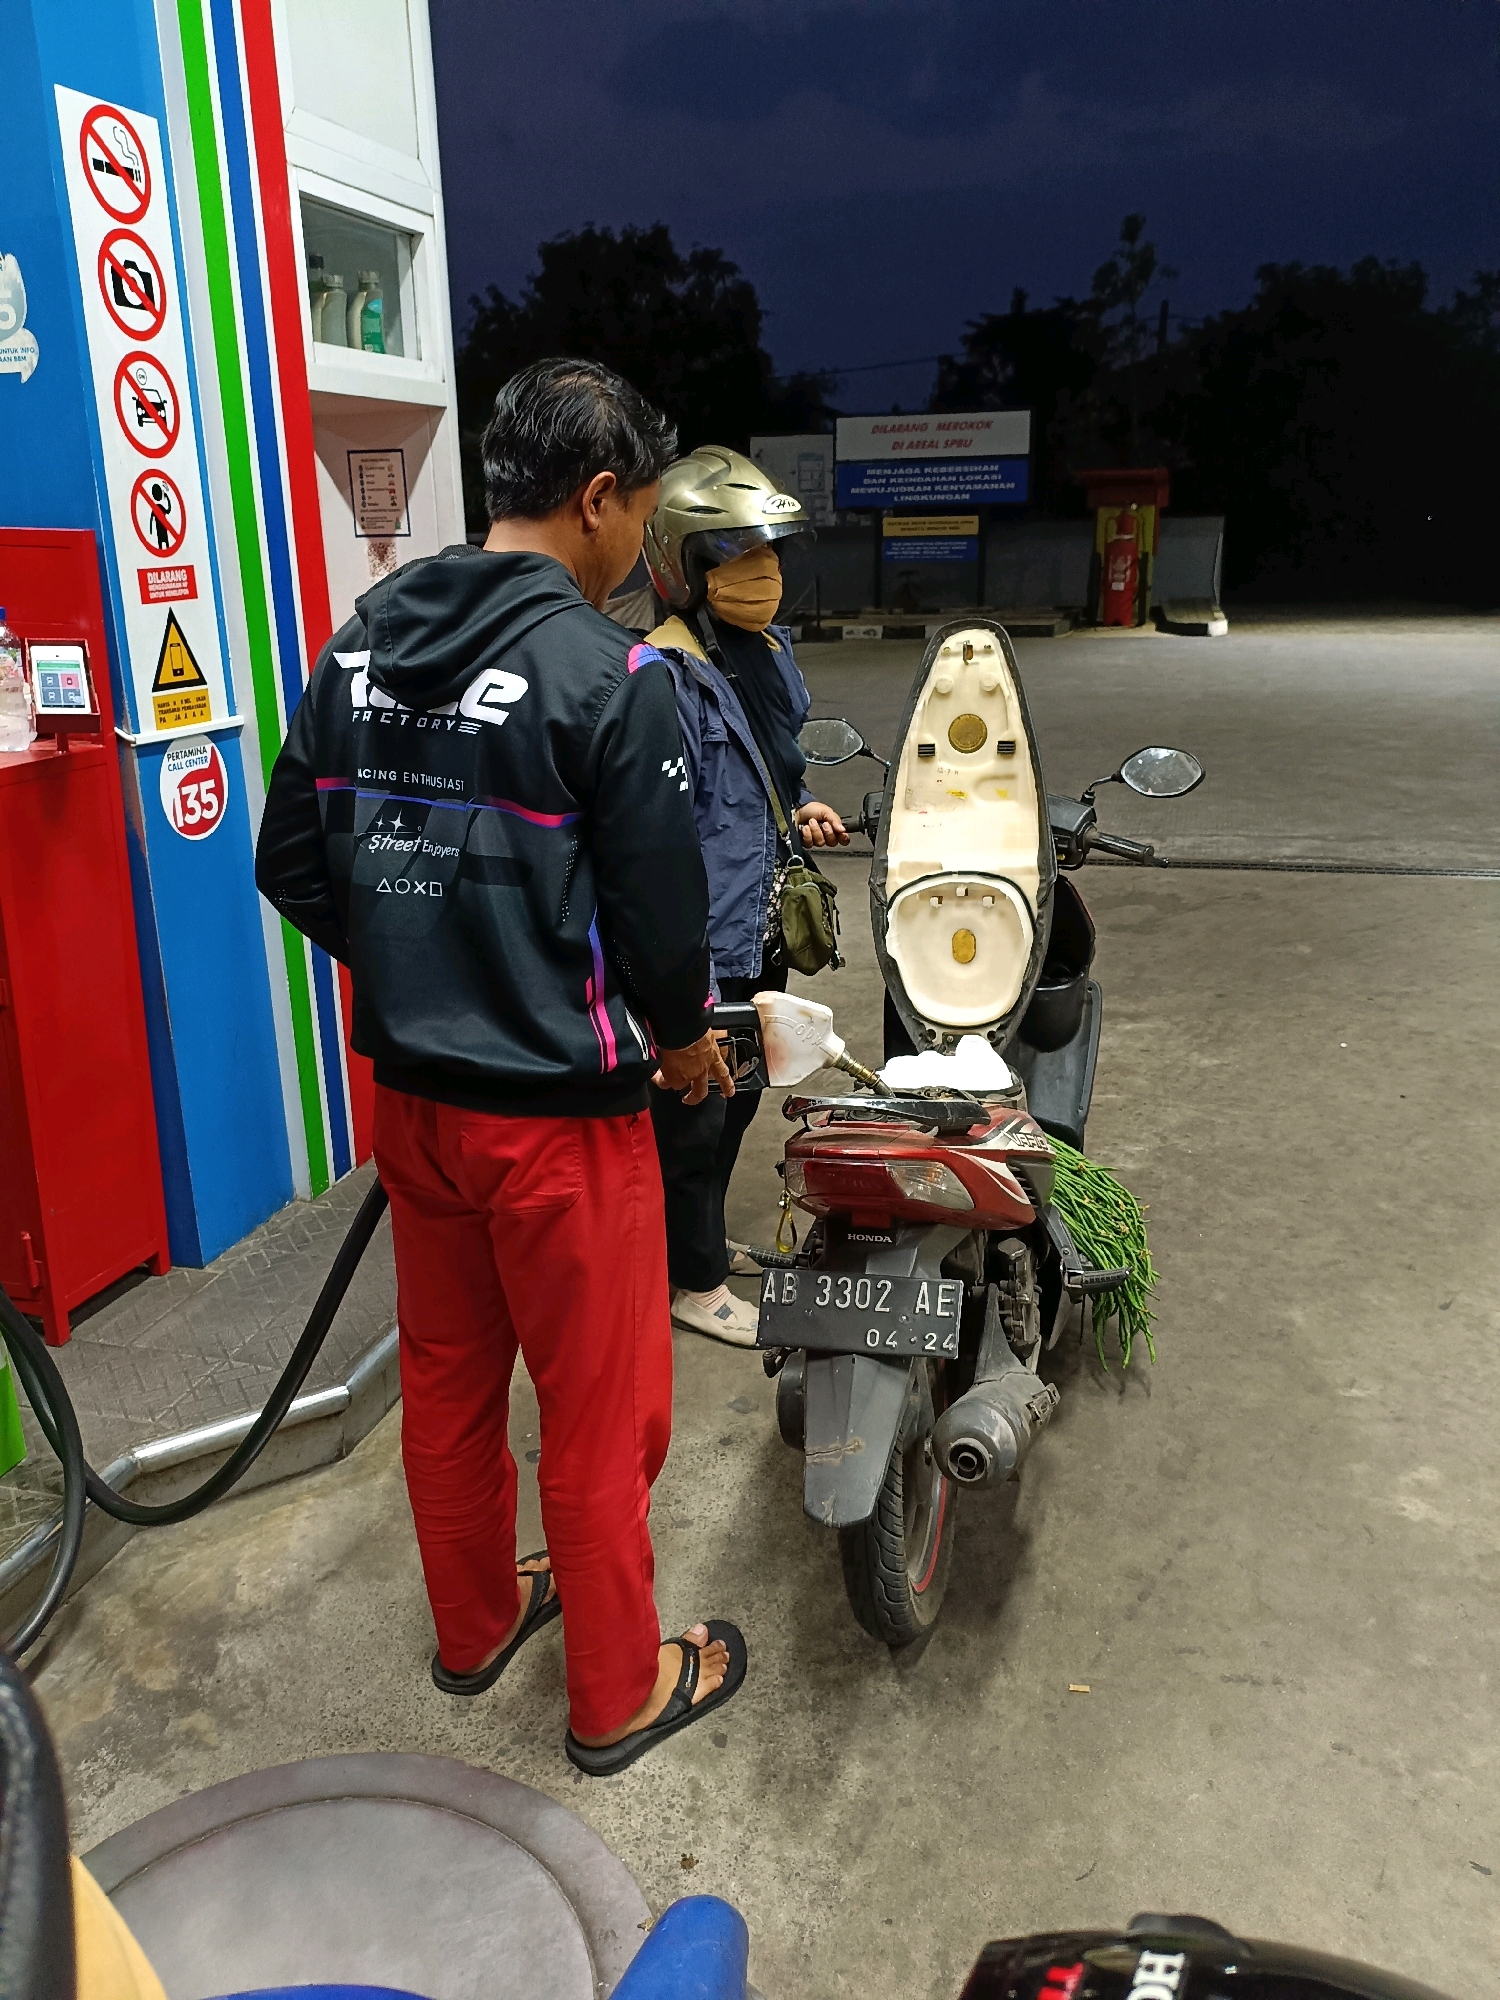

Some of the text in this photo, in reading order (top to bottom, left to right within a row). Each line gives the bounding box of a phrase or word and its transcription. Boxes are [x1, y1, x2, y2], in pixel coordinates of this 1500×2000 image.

[871, 421, 993, 434] DILARANG MEROKOK
[892, 441, 904, 451] DI
[905, 440, 939, 450] AREAL
[866, 465, 999, 475] MENJAGA KEBERSIHAN
[863, 473, 1002, 485] DAN KEINDAHAN LOKASI
[851, 483, 1015, 494] MEWUJUDKAN KENYAMANAN
[893, 493, 970, 502] LINGKUNGAN
[146, 568, 188, 584] DILARANG
[352, 710, 456, 731] FACTORY
[167, 746, 208, 762] PERTAMINA
[168, 755, 209, 772] CALL CENTER
[403, 771, 464, 792] ENTHUSIAST
[173, 779, 219, 828] 135
[368, 833, 460, 858] Street Enjoyers
[847, 1233, 893, 1244] HONDA
[762, 1272, 956, 1317] AB 3302 AE
[866, 1328, 957, 1351] 04 24
